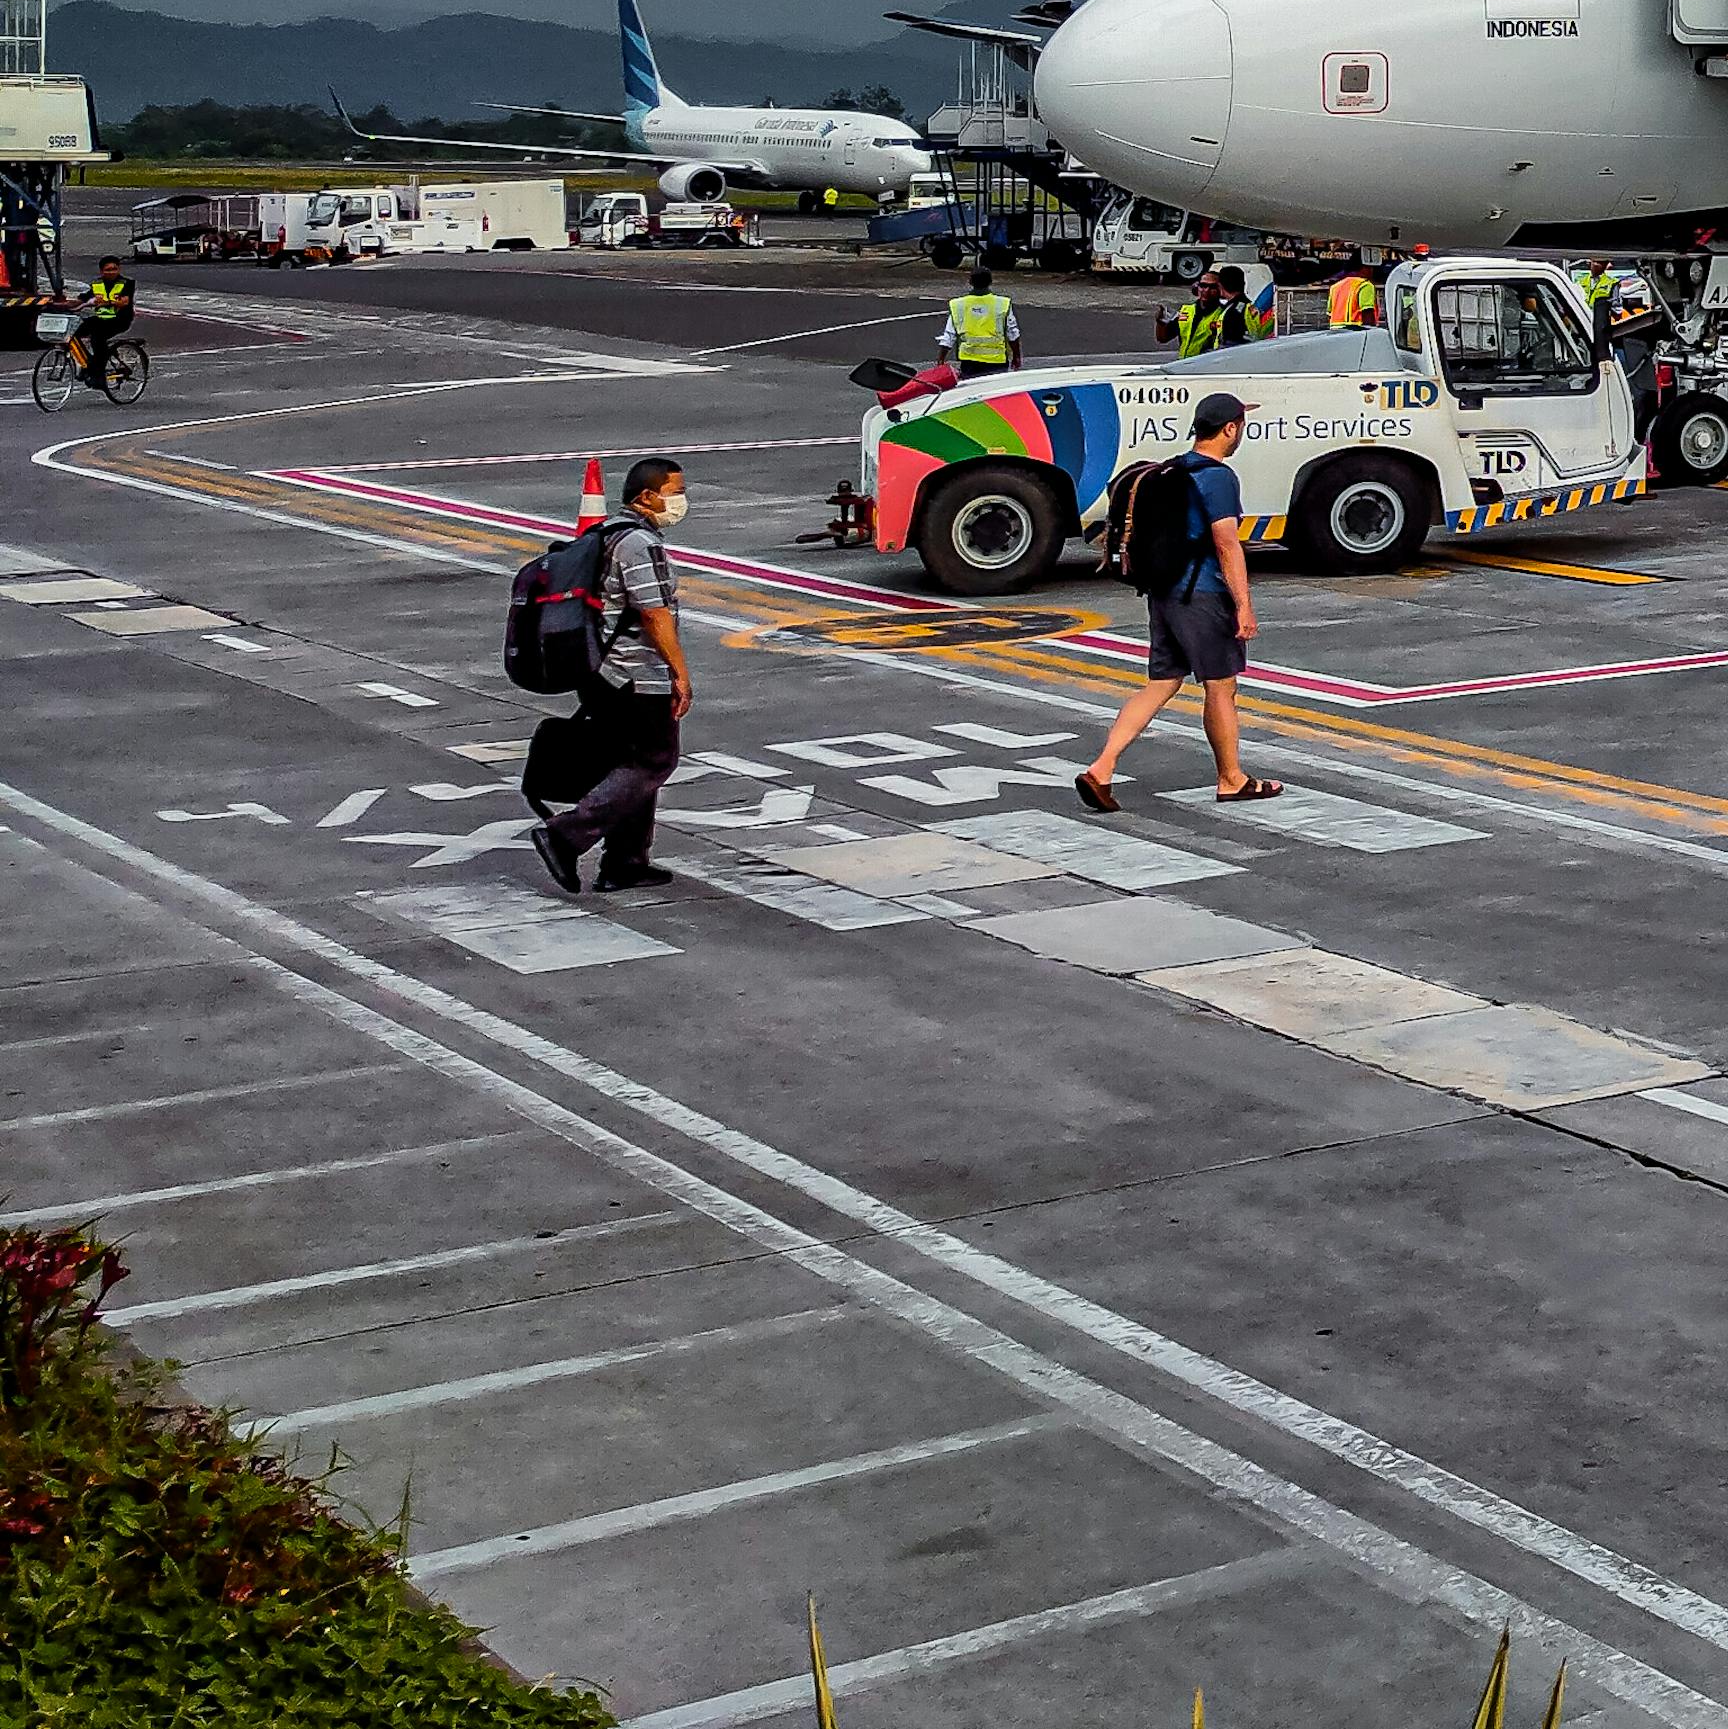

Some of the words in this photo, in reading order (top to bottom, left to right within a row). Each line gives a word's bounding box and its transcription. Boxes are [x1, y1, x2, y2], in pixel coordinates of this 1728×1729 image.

[1486, 20, 1579, 38] INDONESIA
[1118, 387, 1189, 404] 04030
[1381, 380, 1439, 409] TLD
[1128, 417, 1178, 448] JAS
[1294, 413, 1412, 439] Services
[1479, 450, 1527, 474] TLD
